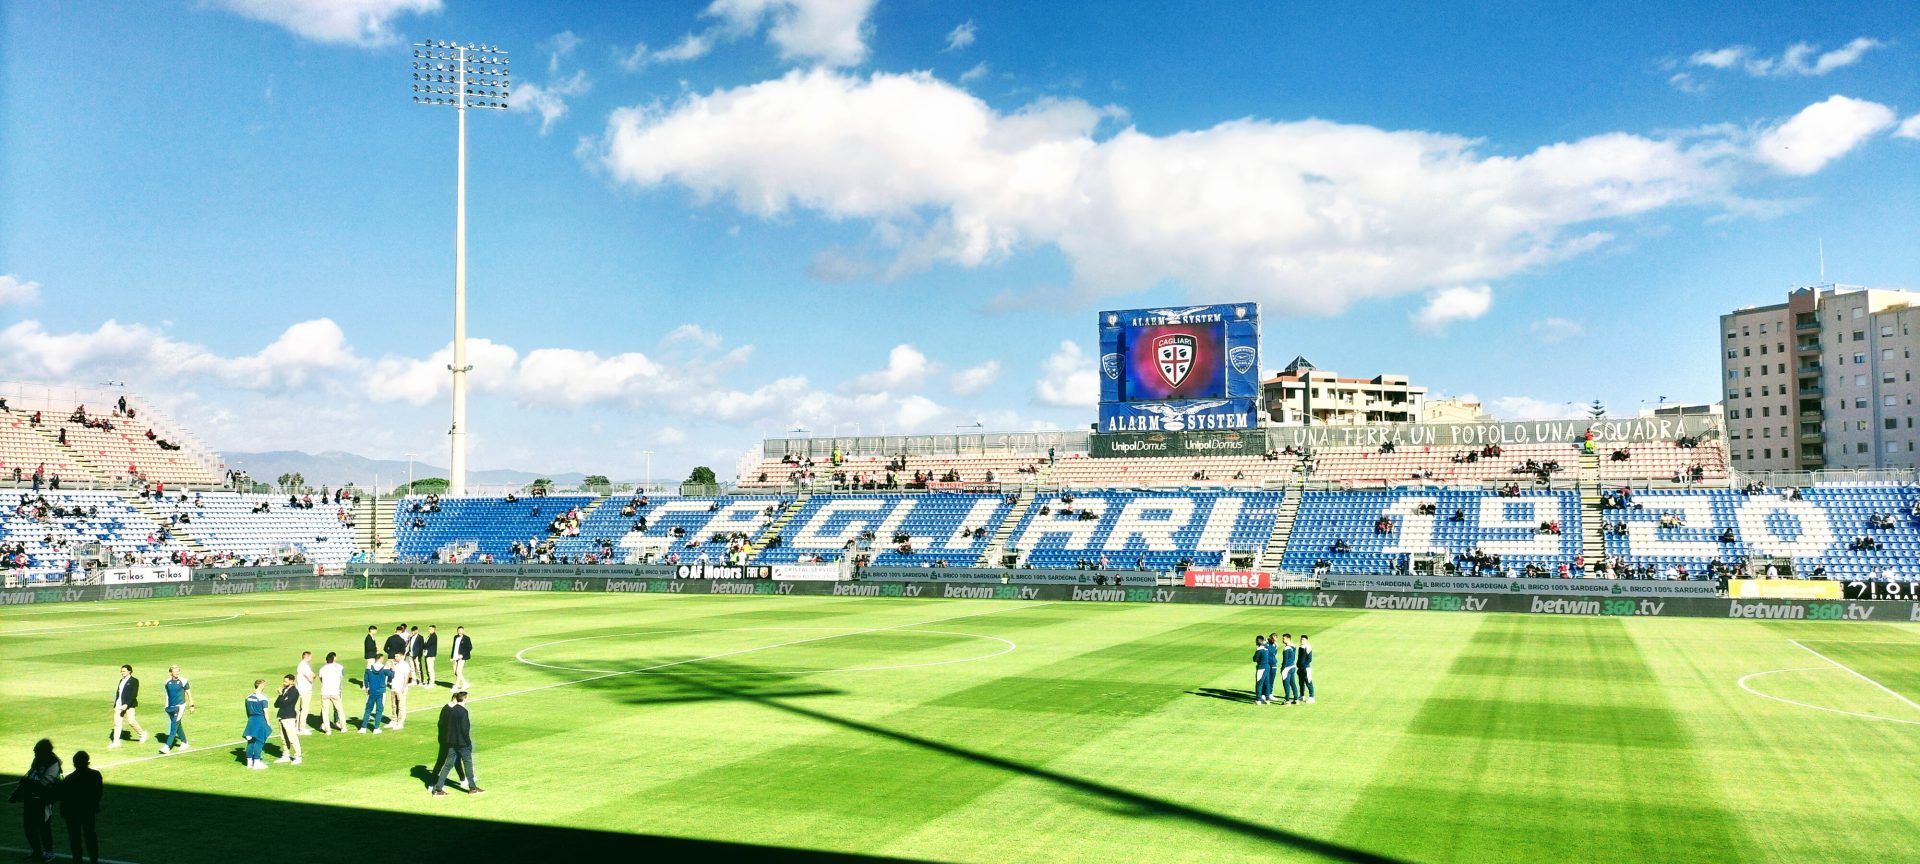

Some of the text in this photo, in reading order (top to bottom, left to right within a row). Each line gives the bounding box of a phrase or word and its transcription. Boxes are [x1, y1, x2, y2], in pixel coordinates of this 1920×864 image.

[1132, 316, 1166, 327] ALARM
[1182, 313, 1222, 325] SYSTEM
[1157, 338, 1193, 348] CAGLIARI
[1108, 412, 1248, 431] ALARM SYSTEM
[1293, 428, 1330, 446] UNA
[1410, 425, 1436, 445] UN
[1449, 424, 1531, 445] POPOLO,
[1535, 422, 1576, 443] UNA
[1590, 418, 1687, 441] SQUADRA
[1111, 440, 1167, 453] UnipolDomus
[1185, 438, 1243, 452] UnipolDomus
[689, 565, 703, 579] AF
[703, 565, 742, 579] Motors
[1194, 572, 1249, 584] welcome
[1570, 584, 1610, 592] SARDEGNA
